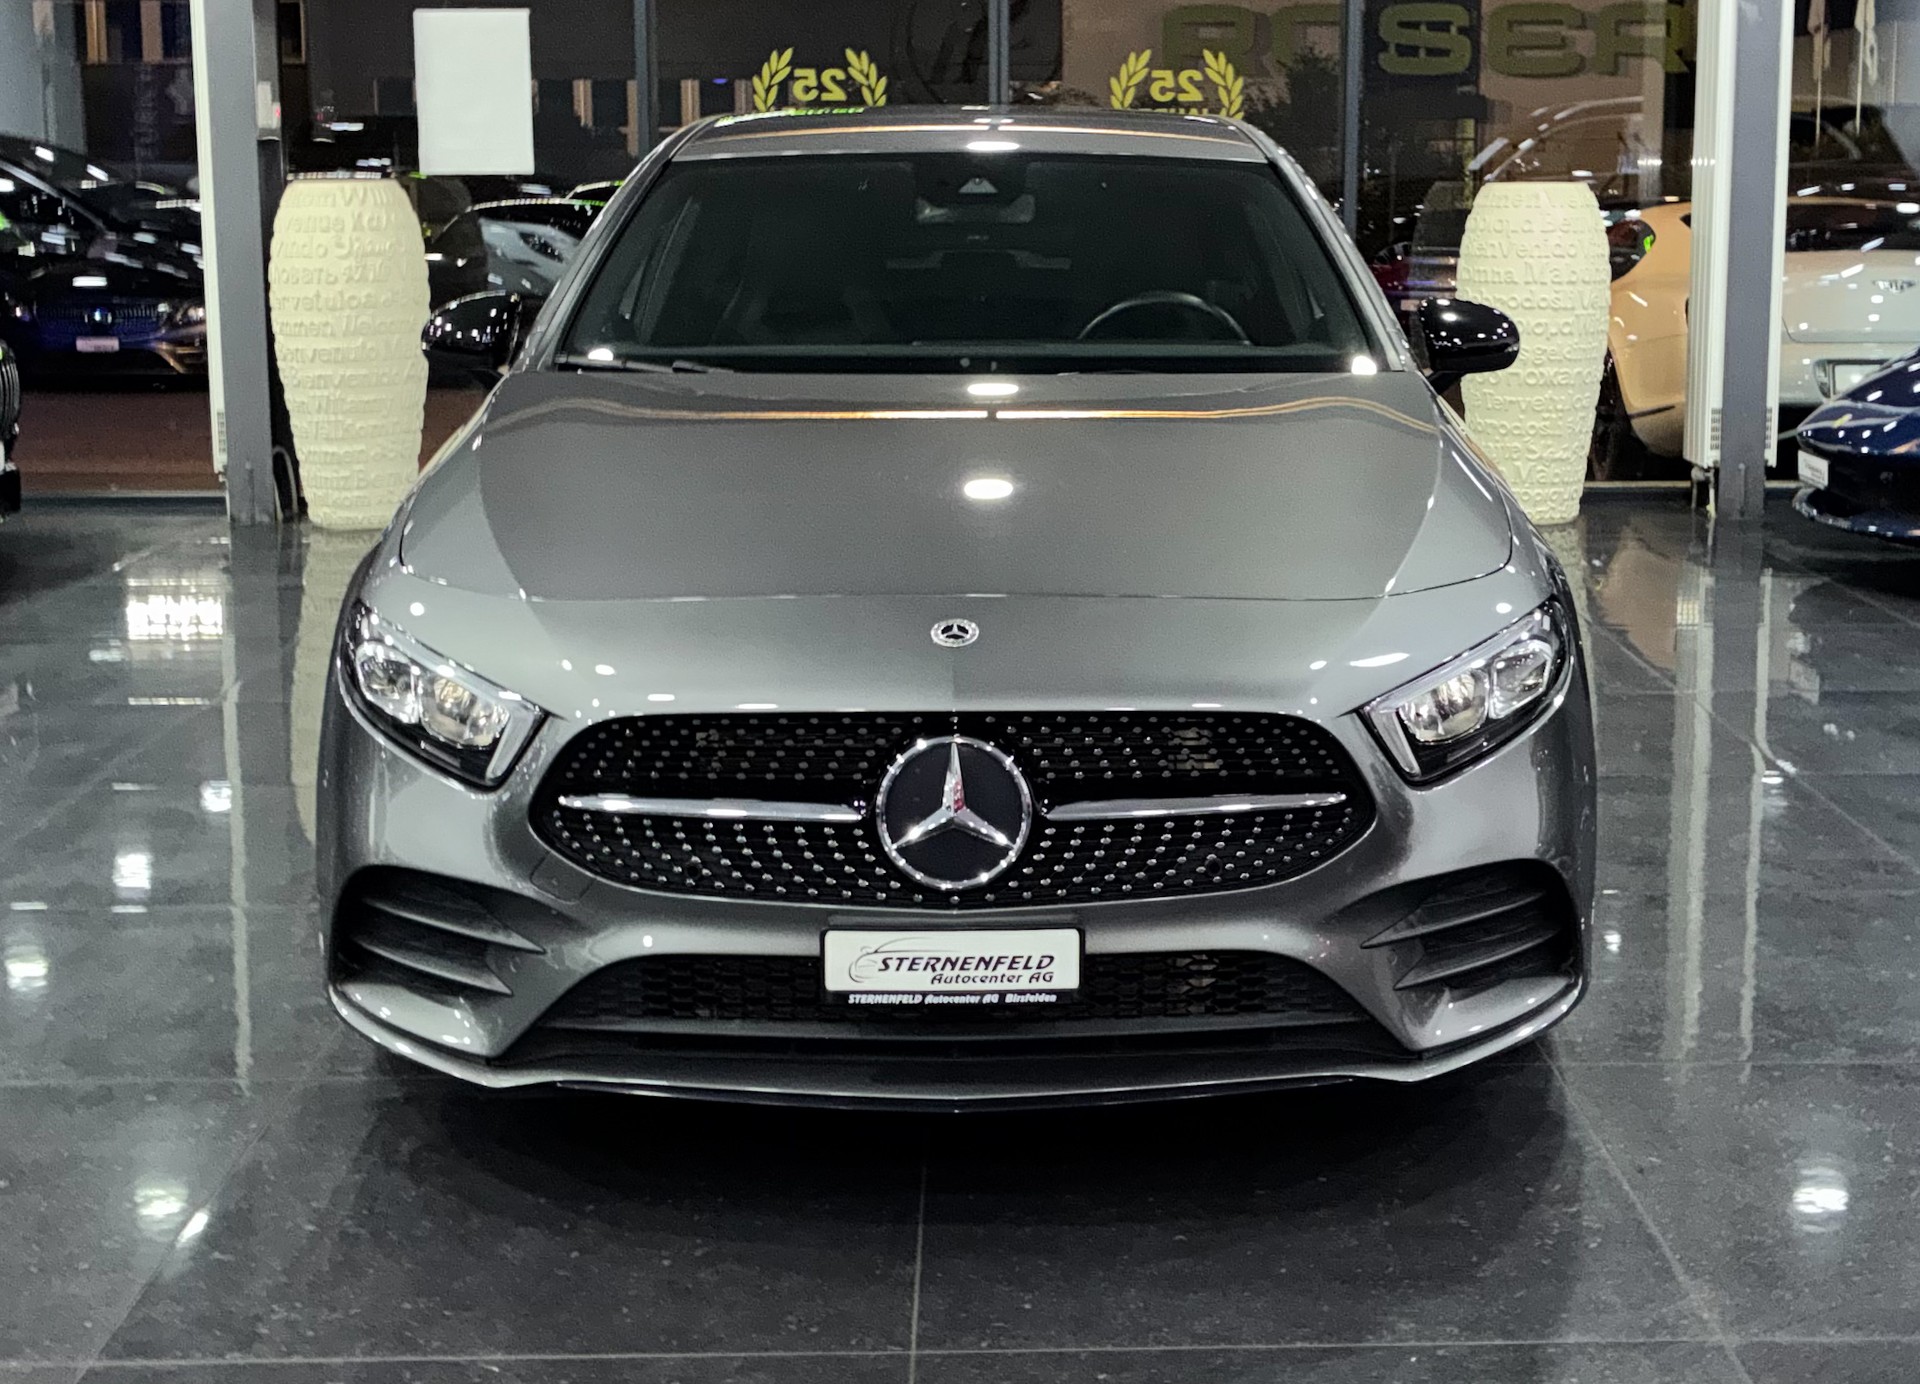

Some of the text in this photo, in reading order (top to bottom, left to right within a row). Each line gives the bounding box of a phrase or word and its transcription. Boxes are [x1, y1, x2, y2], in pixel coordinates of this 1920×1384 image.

[878, 955, 1055, 972] STERNENFELD
[930, 972, 1054, 985] Autocenter AG
[848, 993, 922, 1004] STERNENFELD
[924, 994, 980, 1004] Autocenter
[982, 994, 999, 1004] AG
